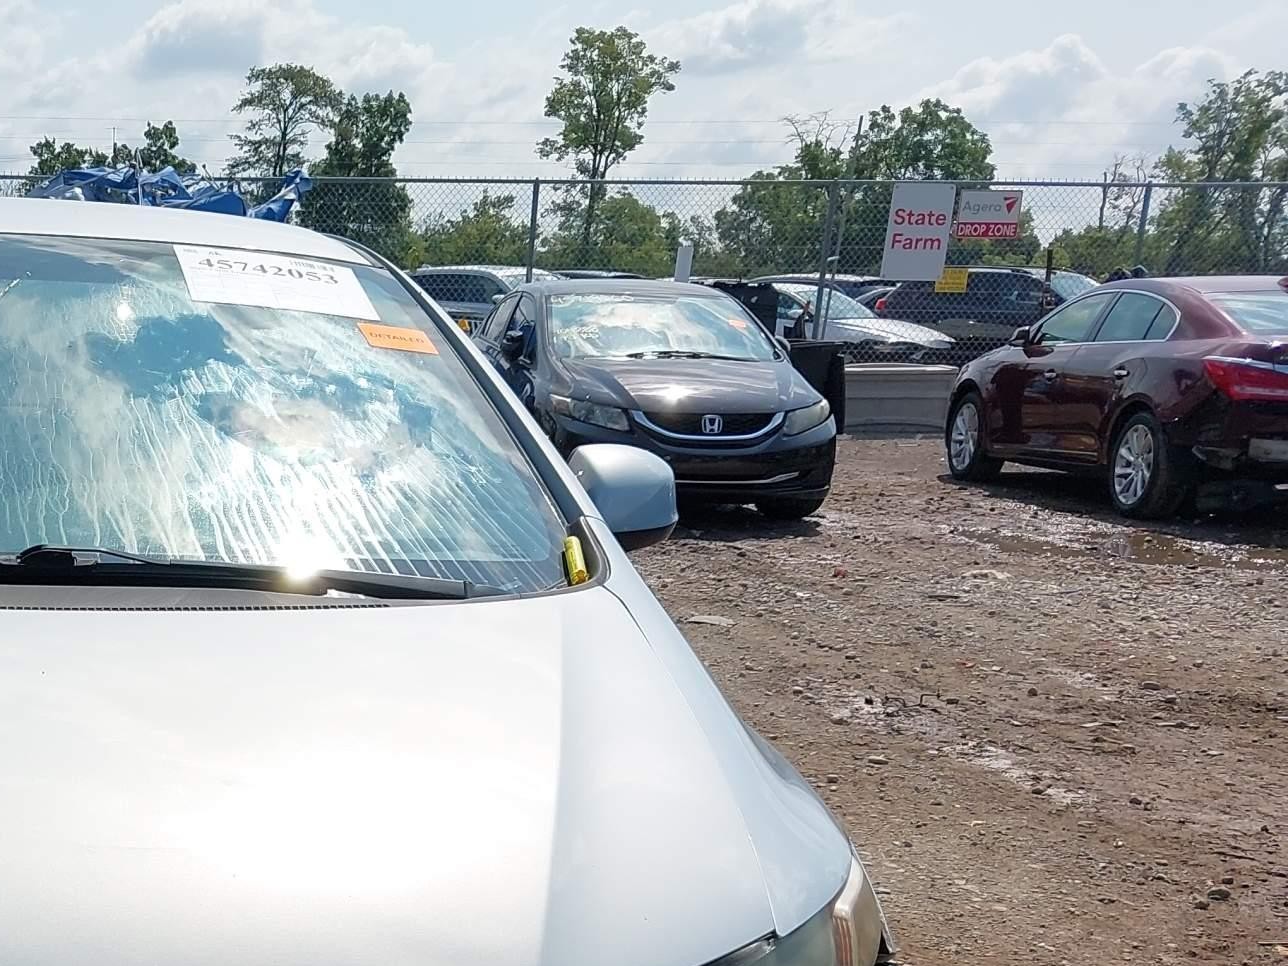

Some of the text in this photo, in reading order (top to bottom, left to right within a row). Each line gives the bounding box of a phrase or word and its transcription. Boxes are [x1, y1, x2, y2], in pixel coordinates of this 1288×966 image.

[962, 200, 1002, 215] Agero
[893, 208, 947, 226] State
[957, 224, 1017, 236] DROP ZONE
[890, 233, 942, 250] Farm
[198, 258, 339, 285] 45742053
